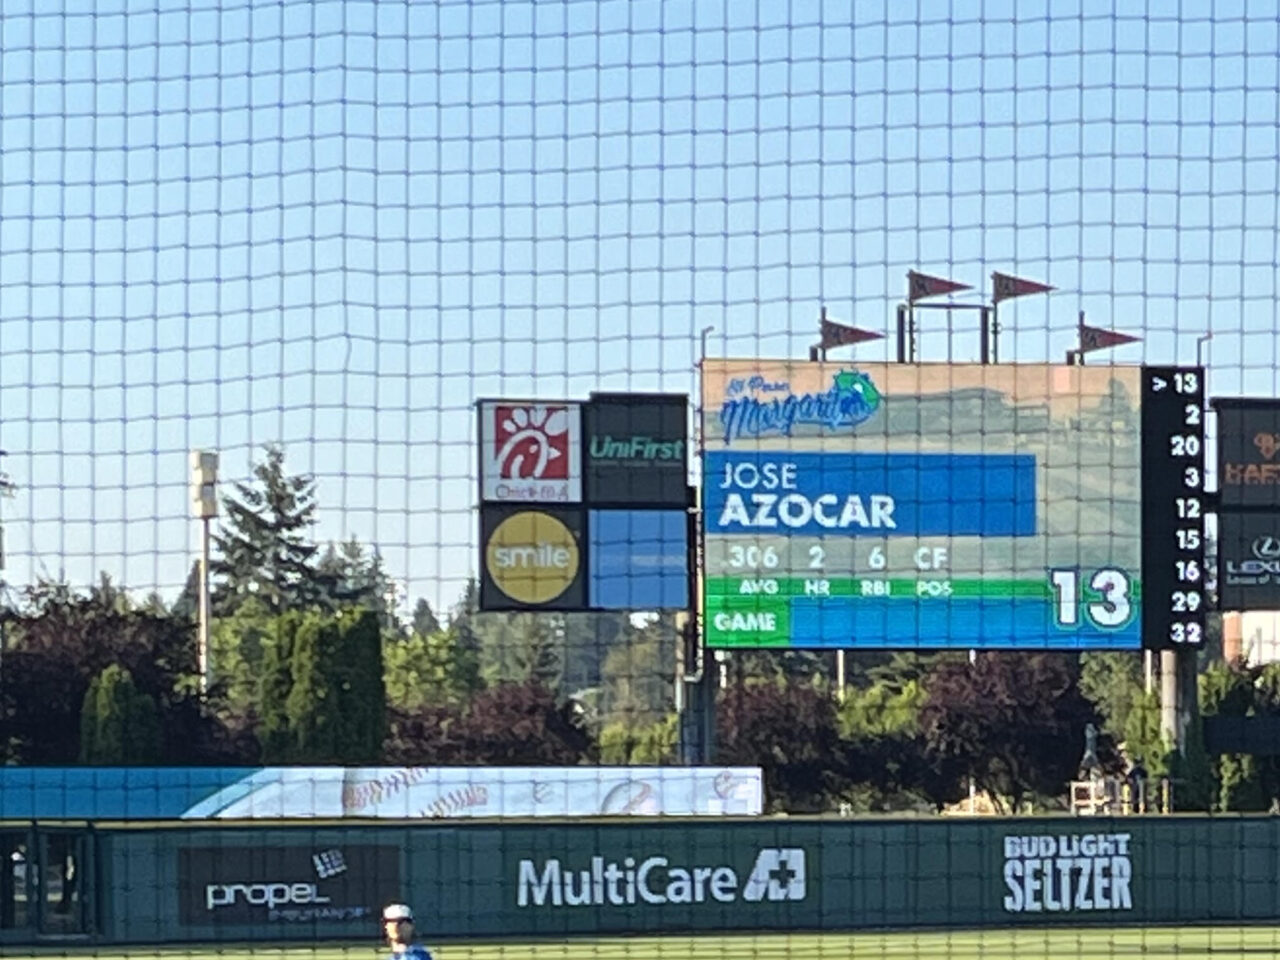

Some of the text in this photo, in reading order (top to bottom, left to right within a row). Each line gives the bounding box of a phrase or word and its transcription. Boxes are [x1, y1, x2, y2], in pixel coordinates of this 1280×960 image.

[1174, 373, 1197, 393] 13
[1185, 404, 1200, 424] 2
[590, 435, 684, 459] UniFirst
[1171, 436, 1199, 456] 20
[719, 462, 797, 489] JOSE
[1185, 467, 1199, 487] 3
[718, 493, 897, 528] AZOCAR
[1176, 498, 1200, 518] 12
[1176, 530, 1200, 549] 15
[495, 541, 570, 568] smile
[808, 545, 824, 569] 2
[868, 546, 886, 569] 6
[913, 547, 947, 570] CF
[1176, 561, 1200, 581] 16
[739, 579, 952, 597] AVG HR RBI POS
[1052, 569, 1131, 627] 13
[1171, 591, 1200, 611] 29
[713, 612, 776, 631] GAME
[1170, 622, 1201, 642] 32
[1004, 833, 1131, 858] BUD LIGHT
[518, 857, 738, 906] MultiCare
[1004, 856, 1132, 912] SELTZER
